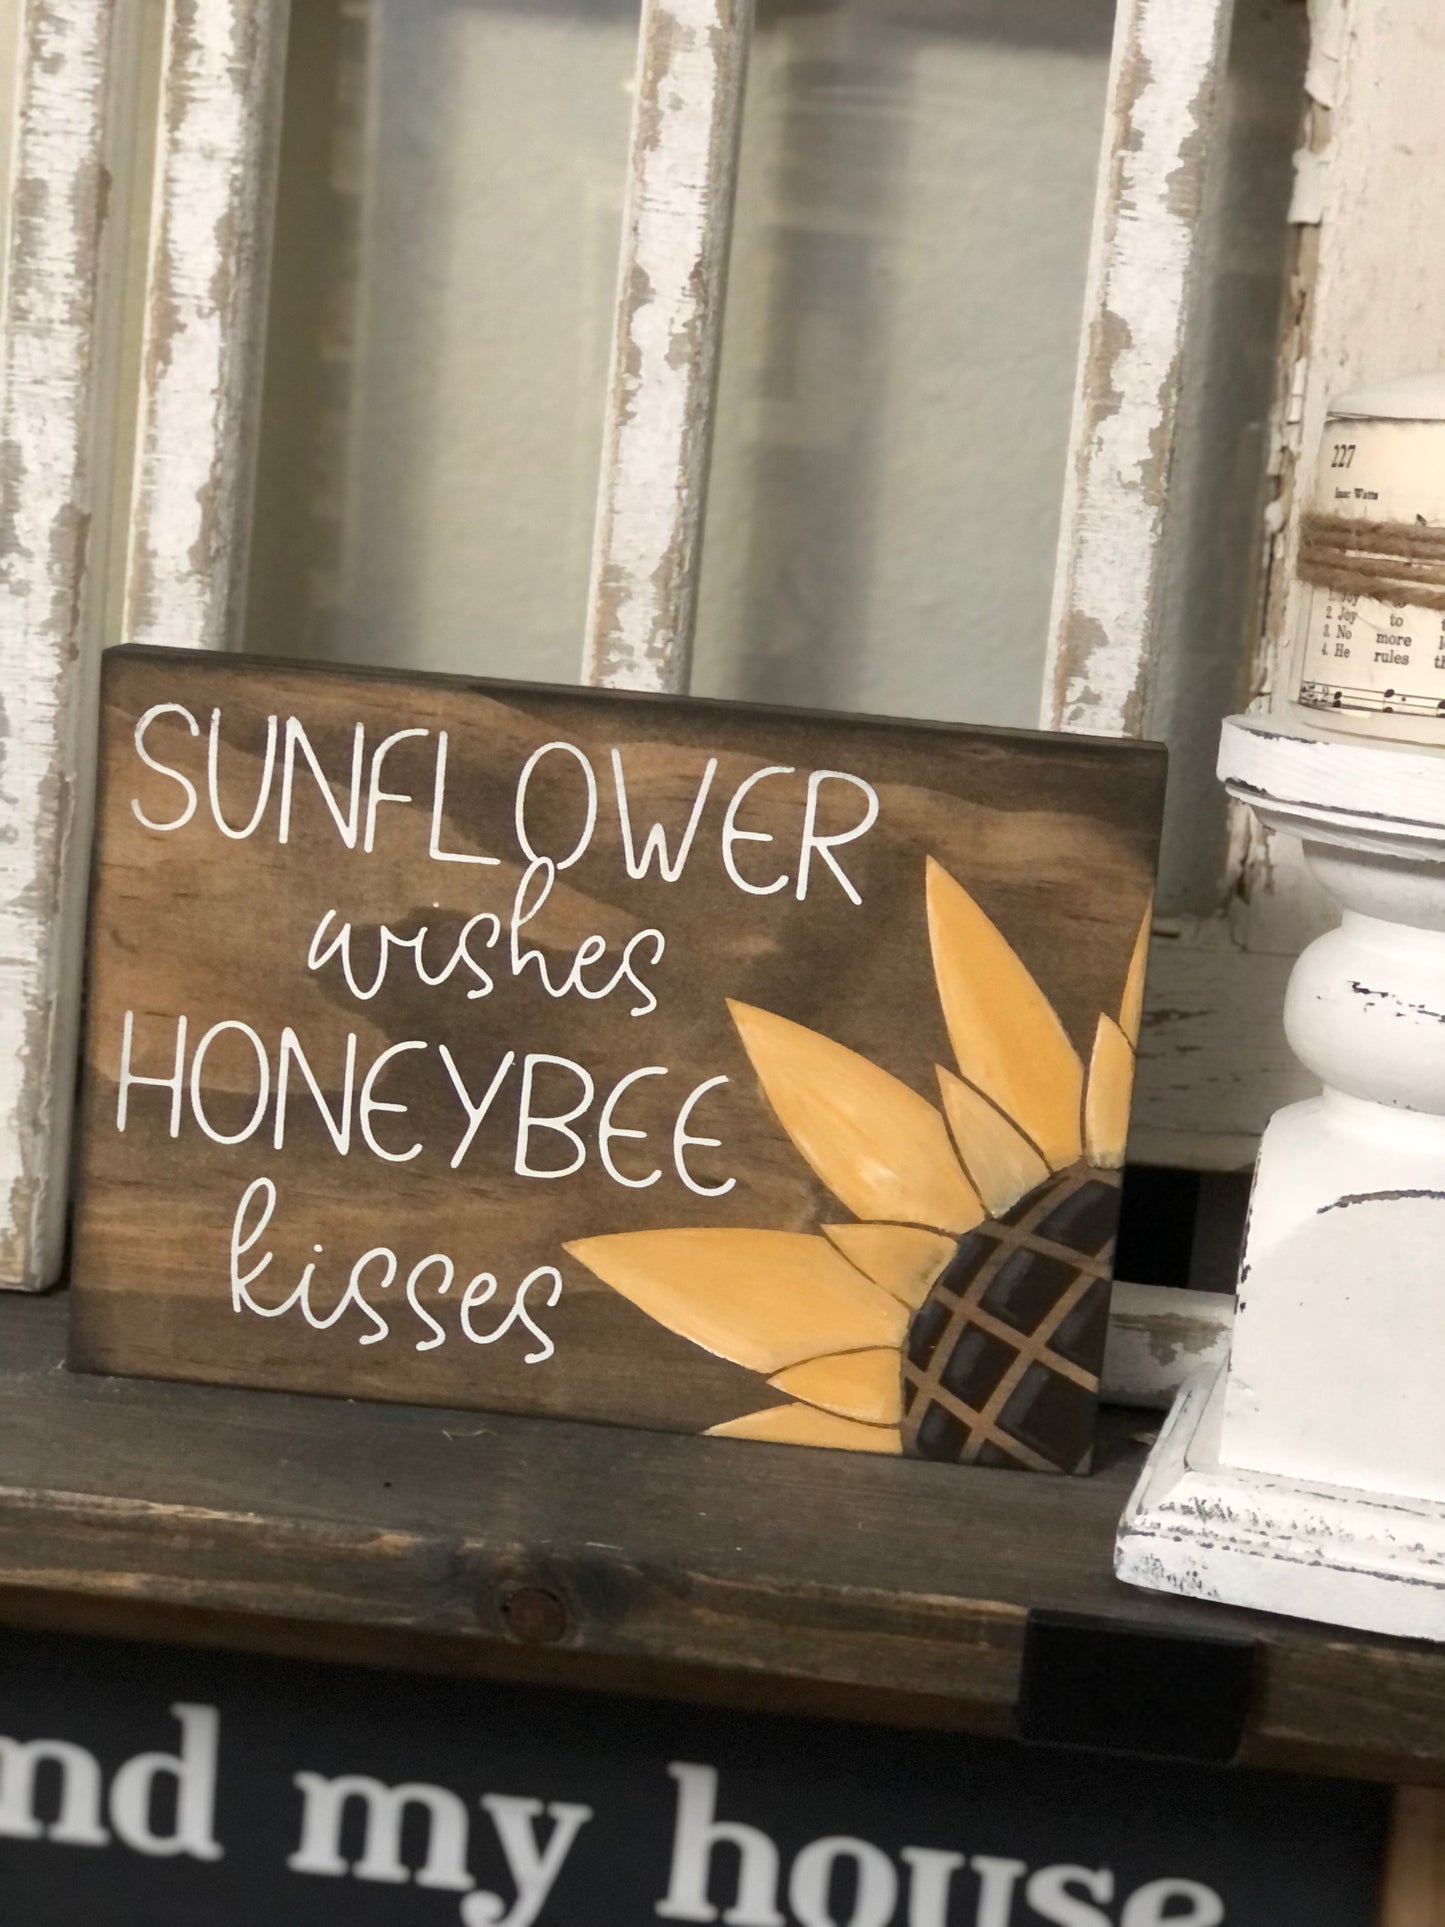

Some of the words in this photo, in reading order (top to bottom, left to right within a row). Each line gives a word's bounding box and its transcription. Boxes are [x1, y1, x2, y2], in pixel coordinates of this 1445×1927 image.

[1331, 444, 1356, 469] 227
[1334, 643, 1351, 658] He
[1374, 649, 1410, 665] rules
[1336, 624, 1352, 640] No
[1376, 633, 1413, 647] more
[1338, 606, 1358, 625] Joy
[1390, 613, 1404, 627] to
[131, 703, 879, 906] SUNFLOWER
[307, 857, 665, 1017] wishes
[116, 1010, 737, 1197] HONEYBEE
[230, 1177, 563, 1365] kisses
[288, 1770, 593, 1927] my
